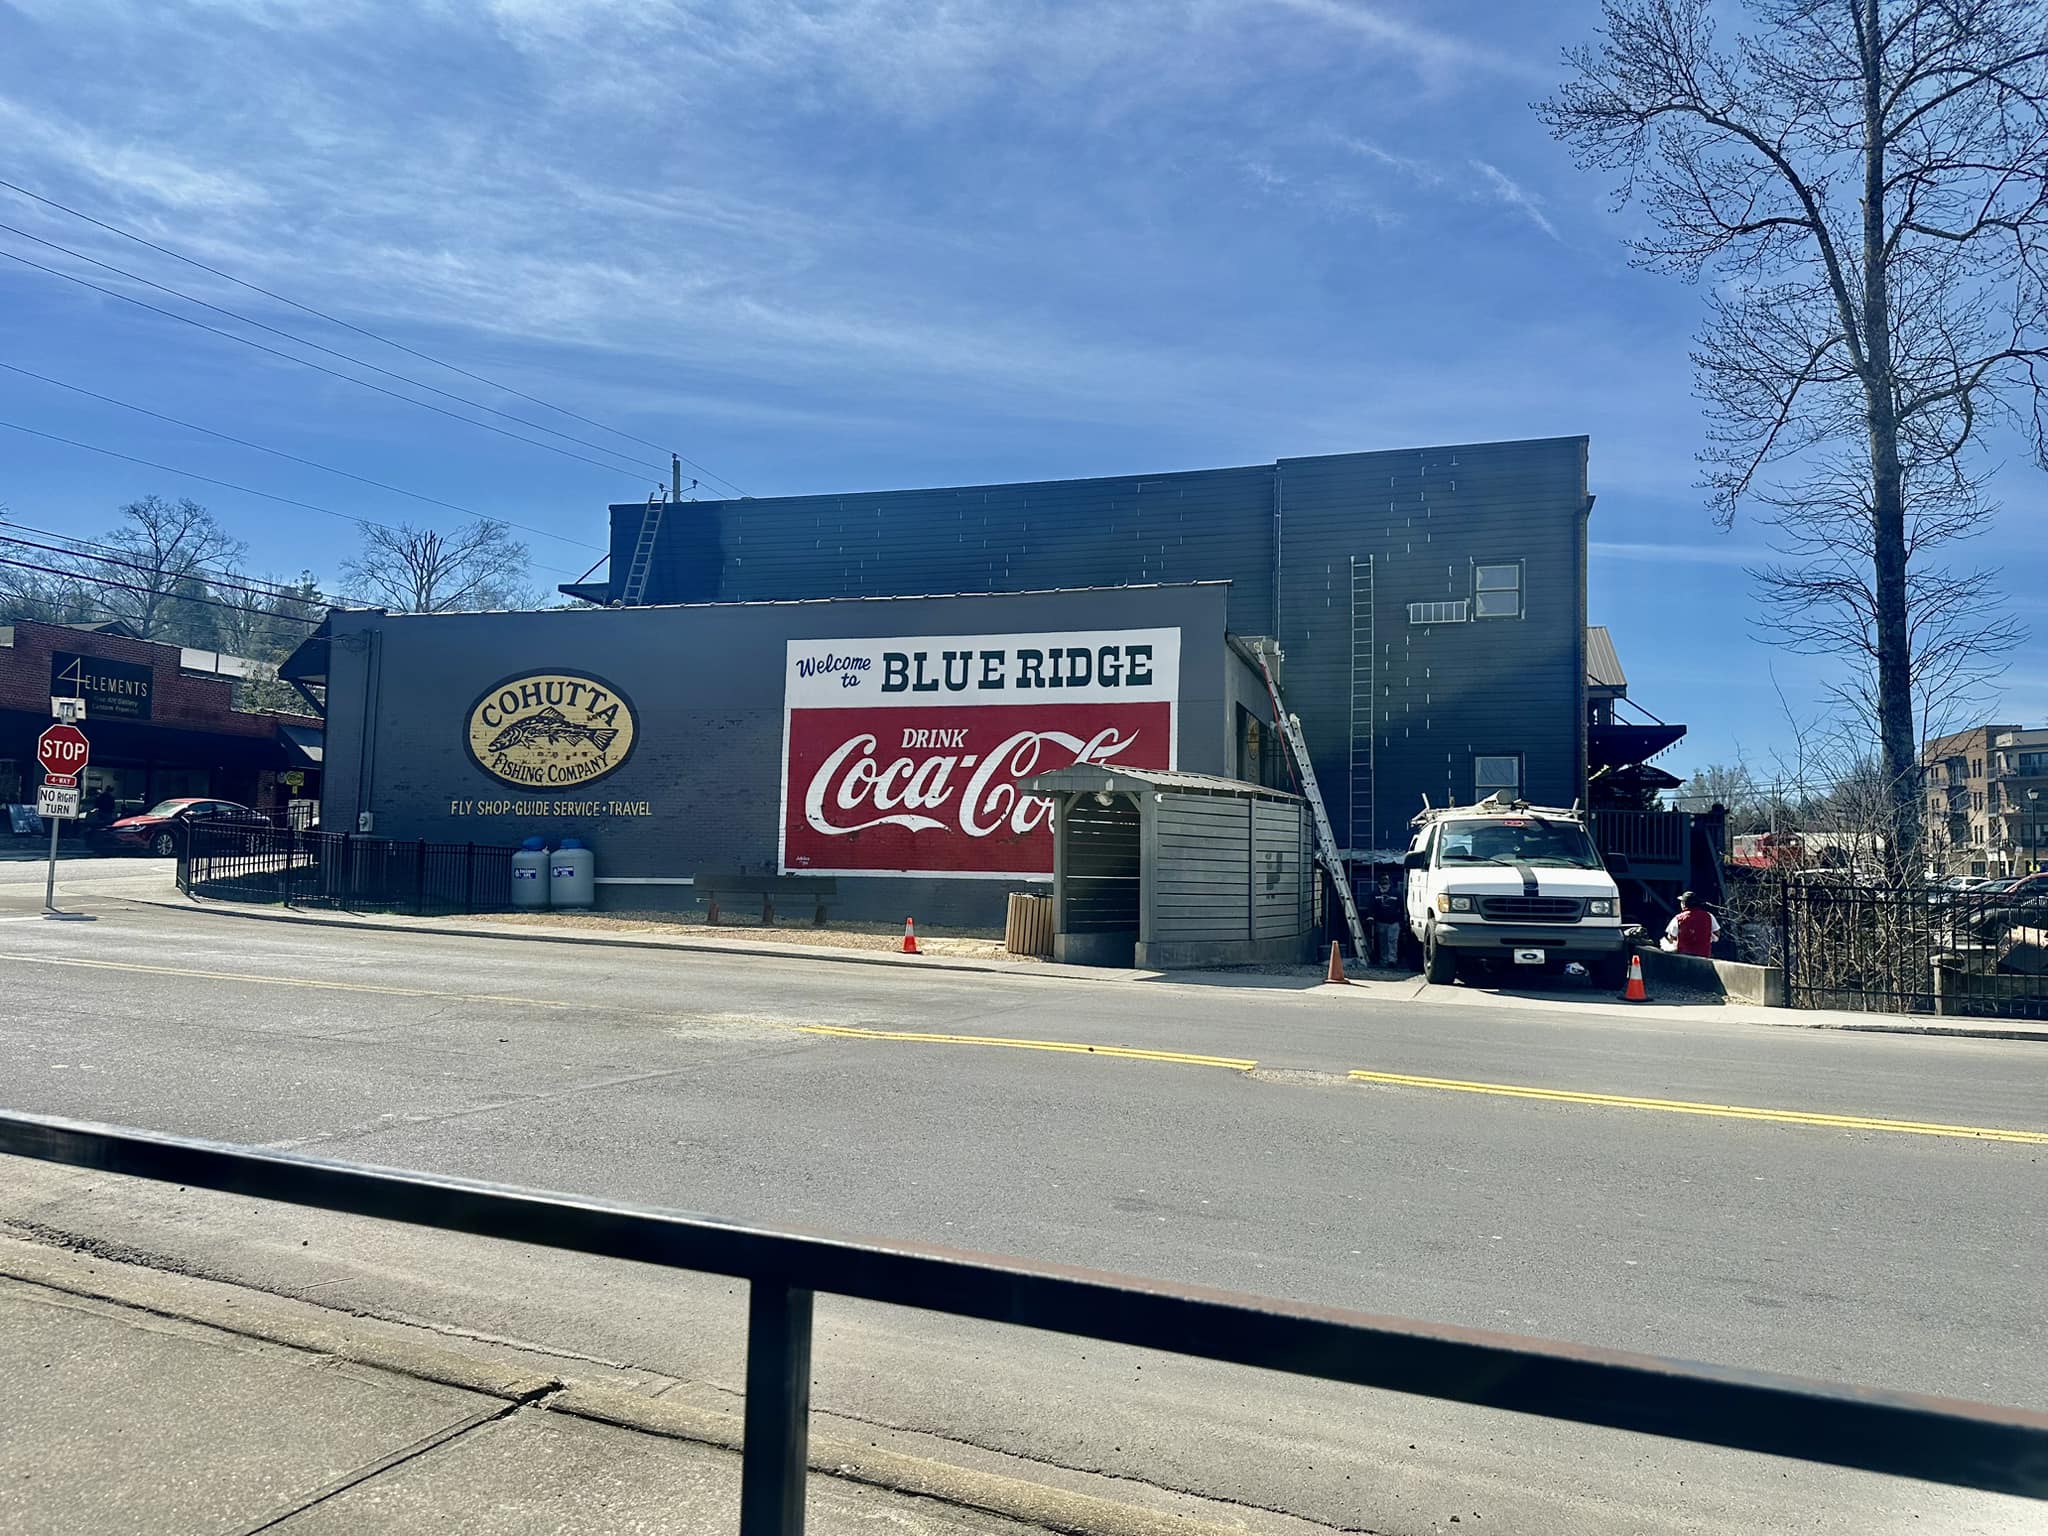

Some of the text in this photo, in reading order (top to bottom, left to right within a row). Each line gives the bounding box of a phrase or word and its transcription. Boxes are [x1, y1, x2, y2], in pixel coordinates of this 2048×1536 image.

[57, 657, 148, 698] 4 ELEMENTS
[796, 654, 872, 679] Welcome
[881, 644, 1153, 693] BLUE RIDGE
[841, 673, 861, 688] to
[481, 681, 620, 727] COHUTTA
[901, 728, 969, 749] DRINK
[42, 739, 86, 761] STOP
[492, 752, 609, 783] FISHING COMPANY
[40, 789, 77, 803] NO RIGHT
[45, 803, 70, 815] TURN
[451, 800, 473, 815] FLY
